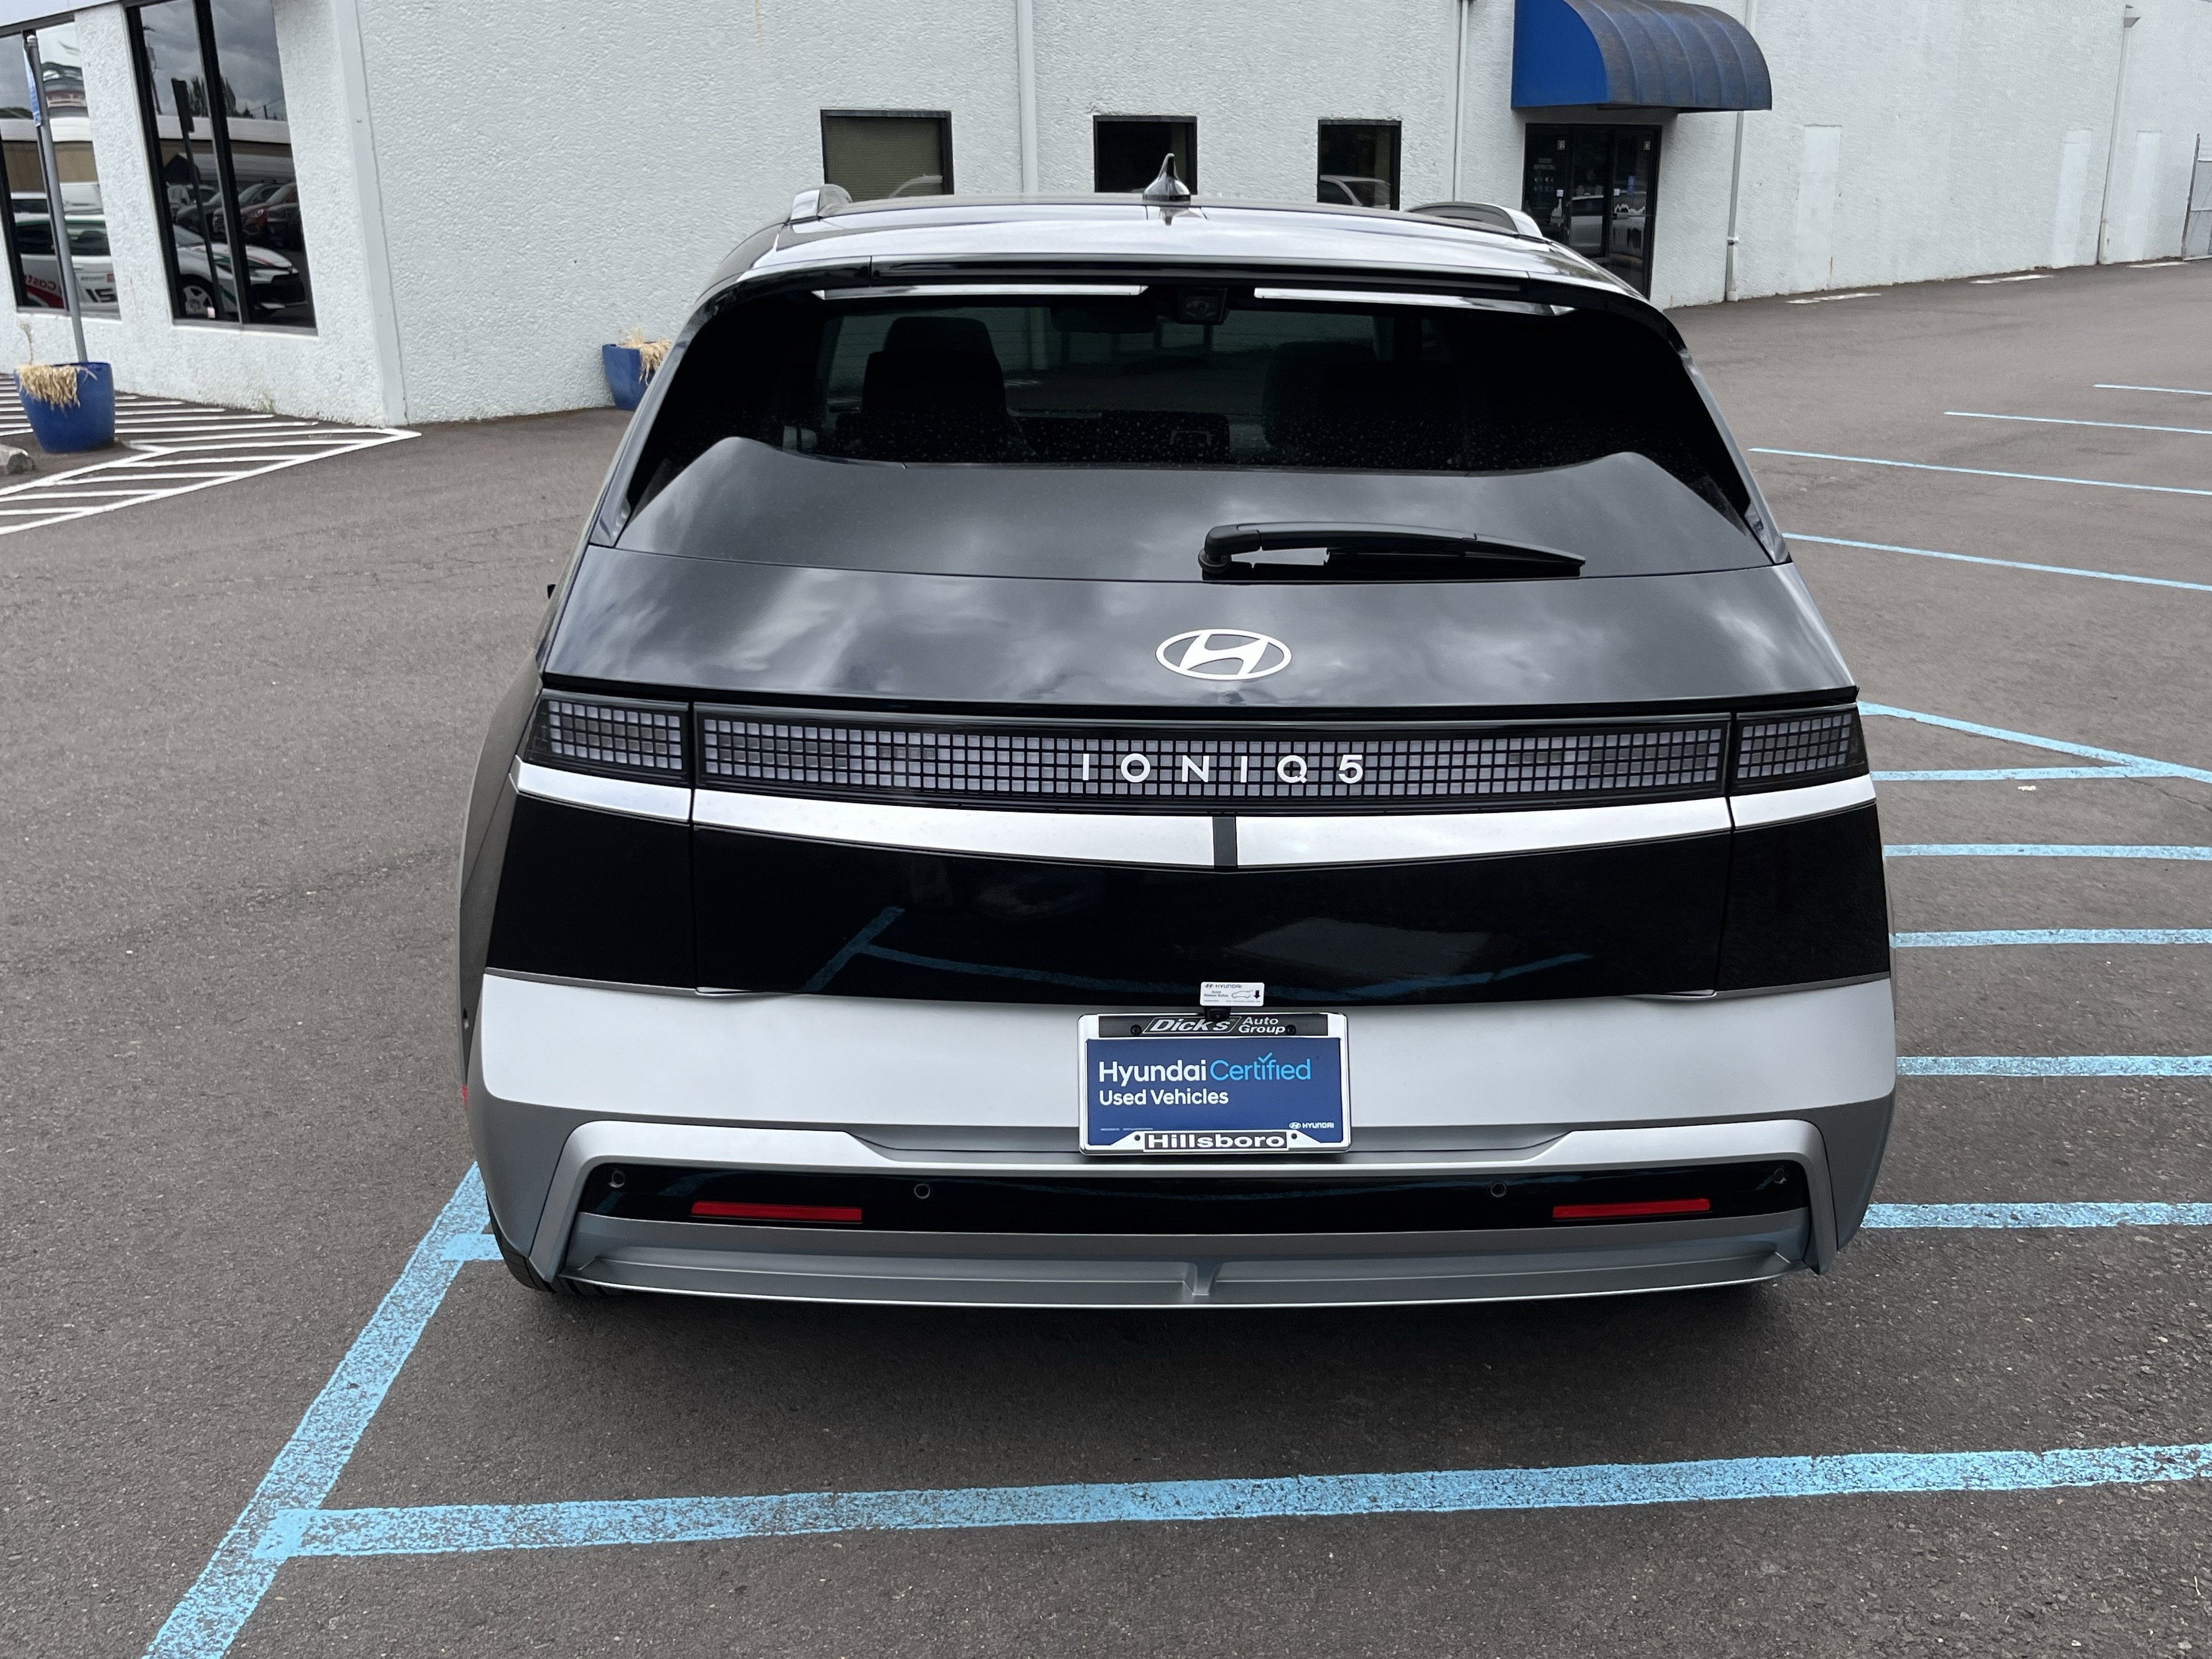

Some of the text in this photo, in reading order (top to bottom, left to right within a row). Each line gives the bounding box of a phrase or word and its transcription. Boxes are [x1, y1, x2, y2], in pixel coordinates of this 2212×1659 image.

[1082, 753, 1363, 784] IONIQ 5
[1150, 1018, 1231, 1031] Dicks
[1242, 1017, 1279, 1025] Auto
[1238, 1025, 1286, 1035] Group
[1099, 1053, 1311, 1086] Hyundai Certified
[1099, 1088, 1229, 1105] Used Vehicles
[1148, 1134, 1285, 1148] Hillsboro
